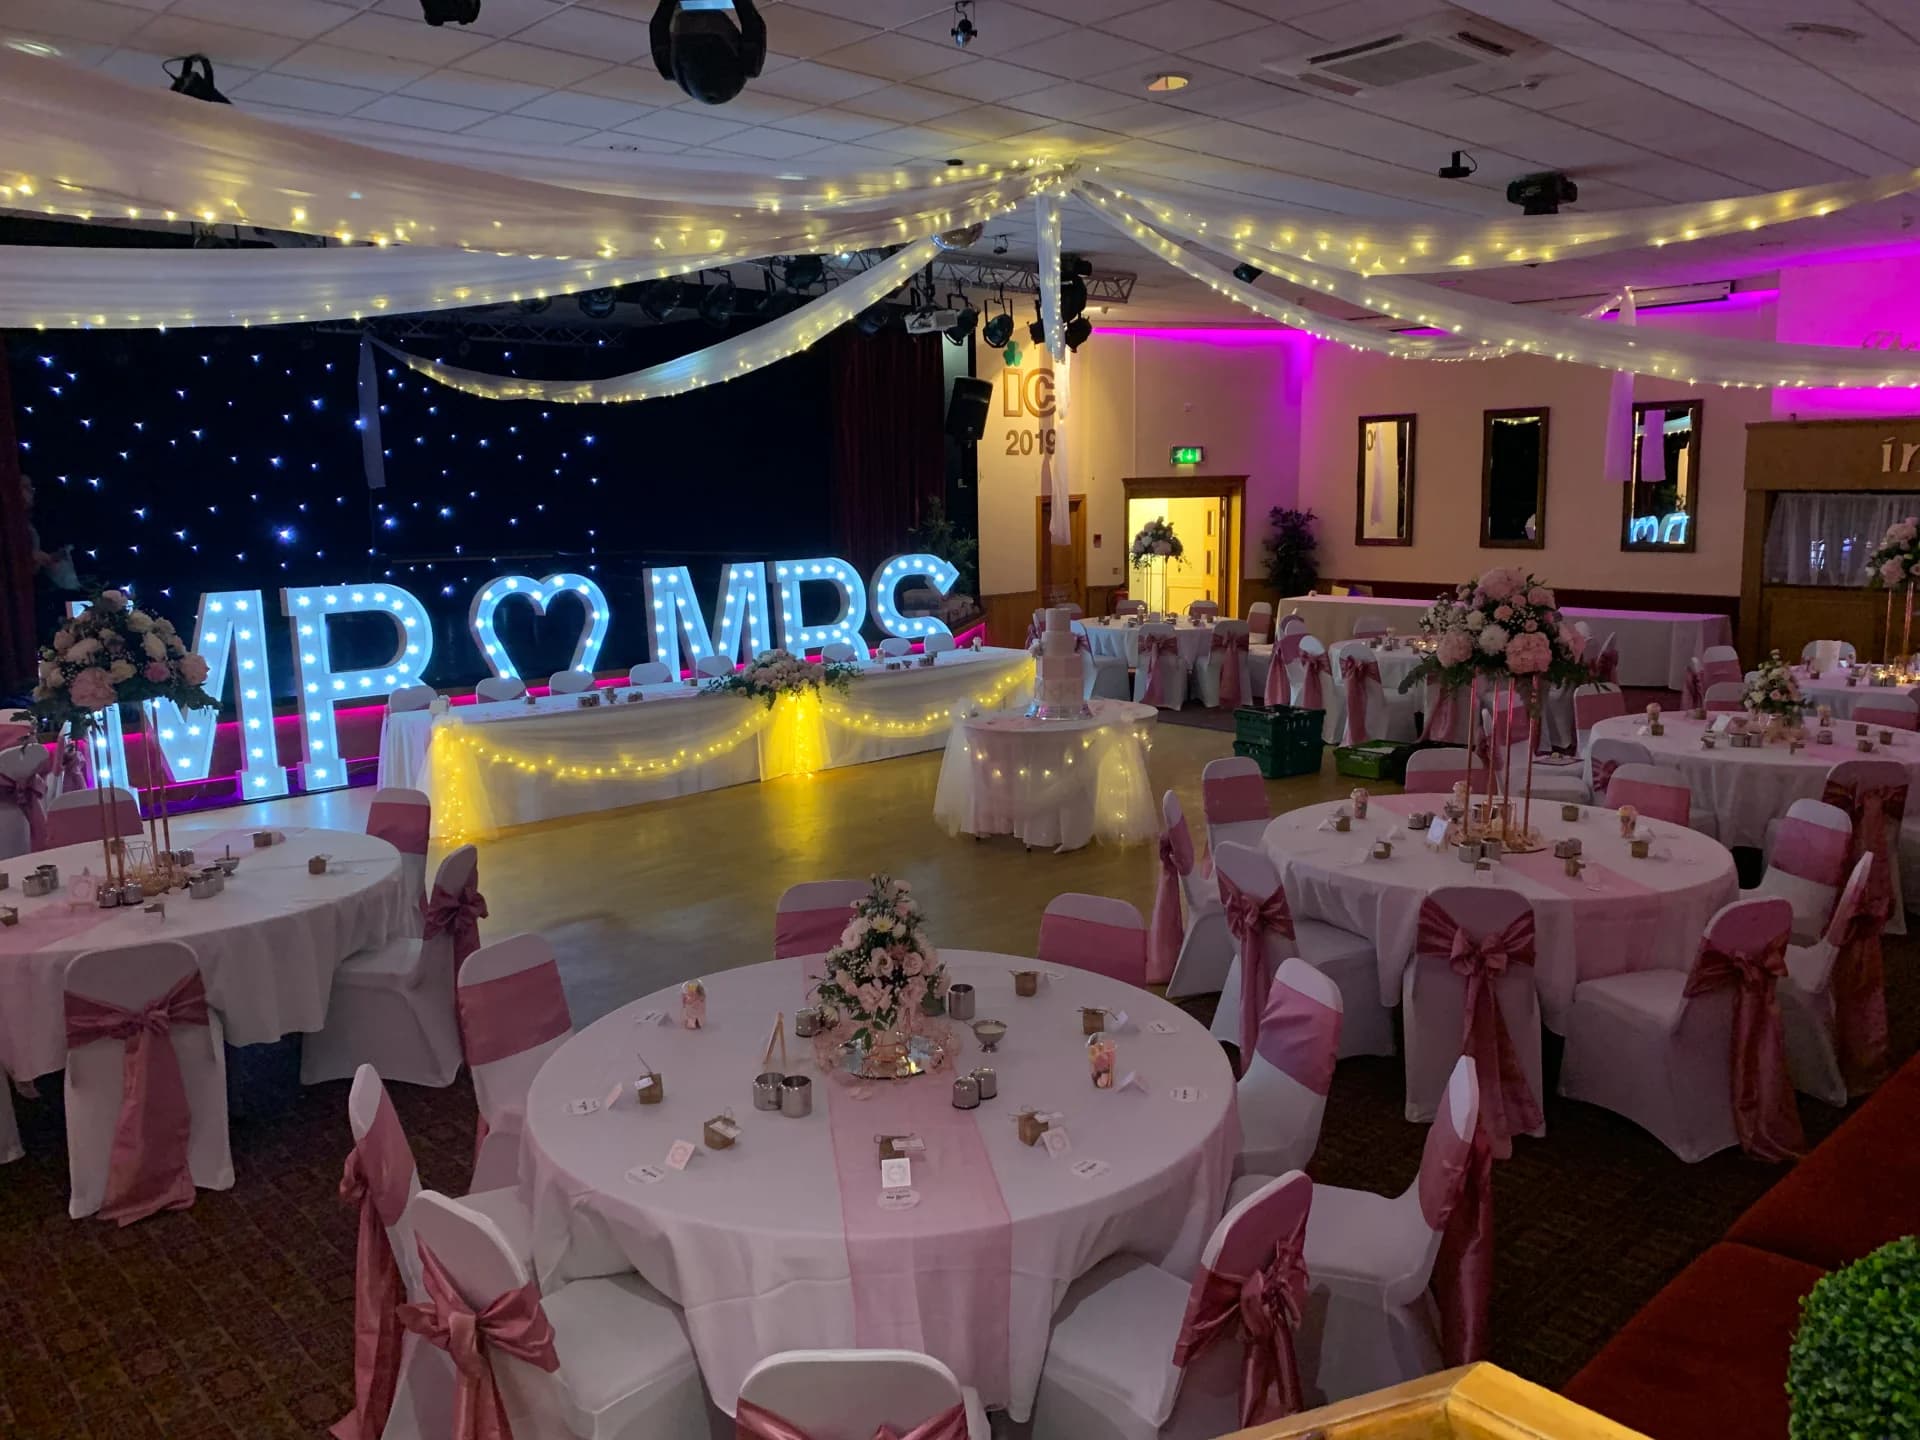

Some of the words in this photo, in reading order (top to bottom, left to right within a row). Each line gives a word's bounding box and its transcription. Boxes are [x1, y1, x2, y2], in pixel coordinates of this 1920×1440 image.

[1003, 367, 1056, 418] IC
[1005, 428, 1056, 456] 2019
[642, 553, 960, 682] MRS
